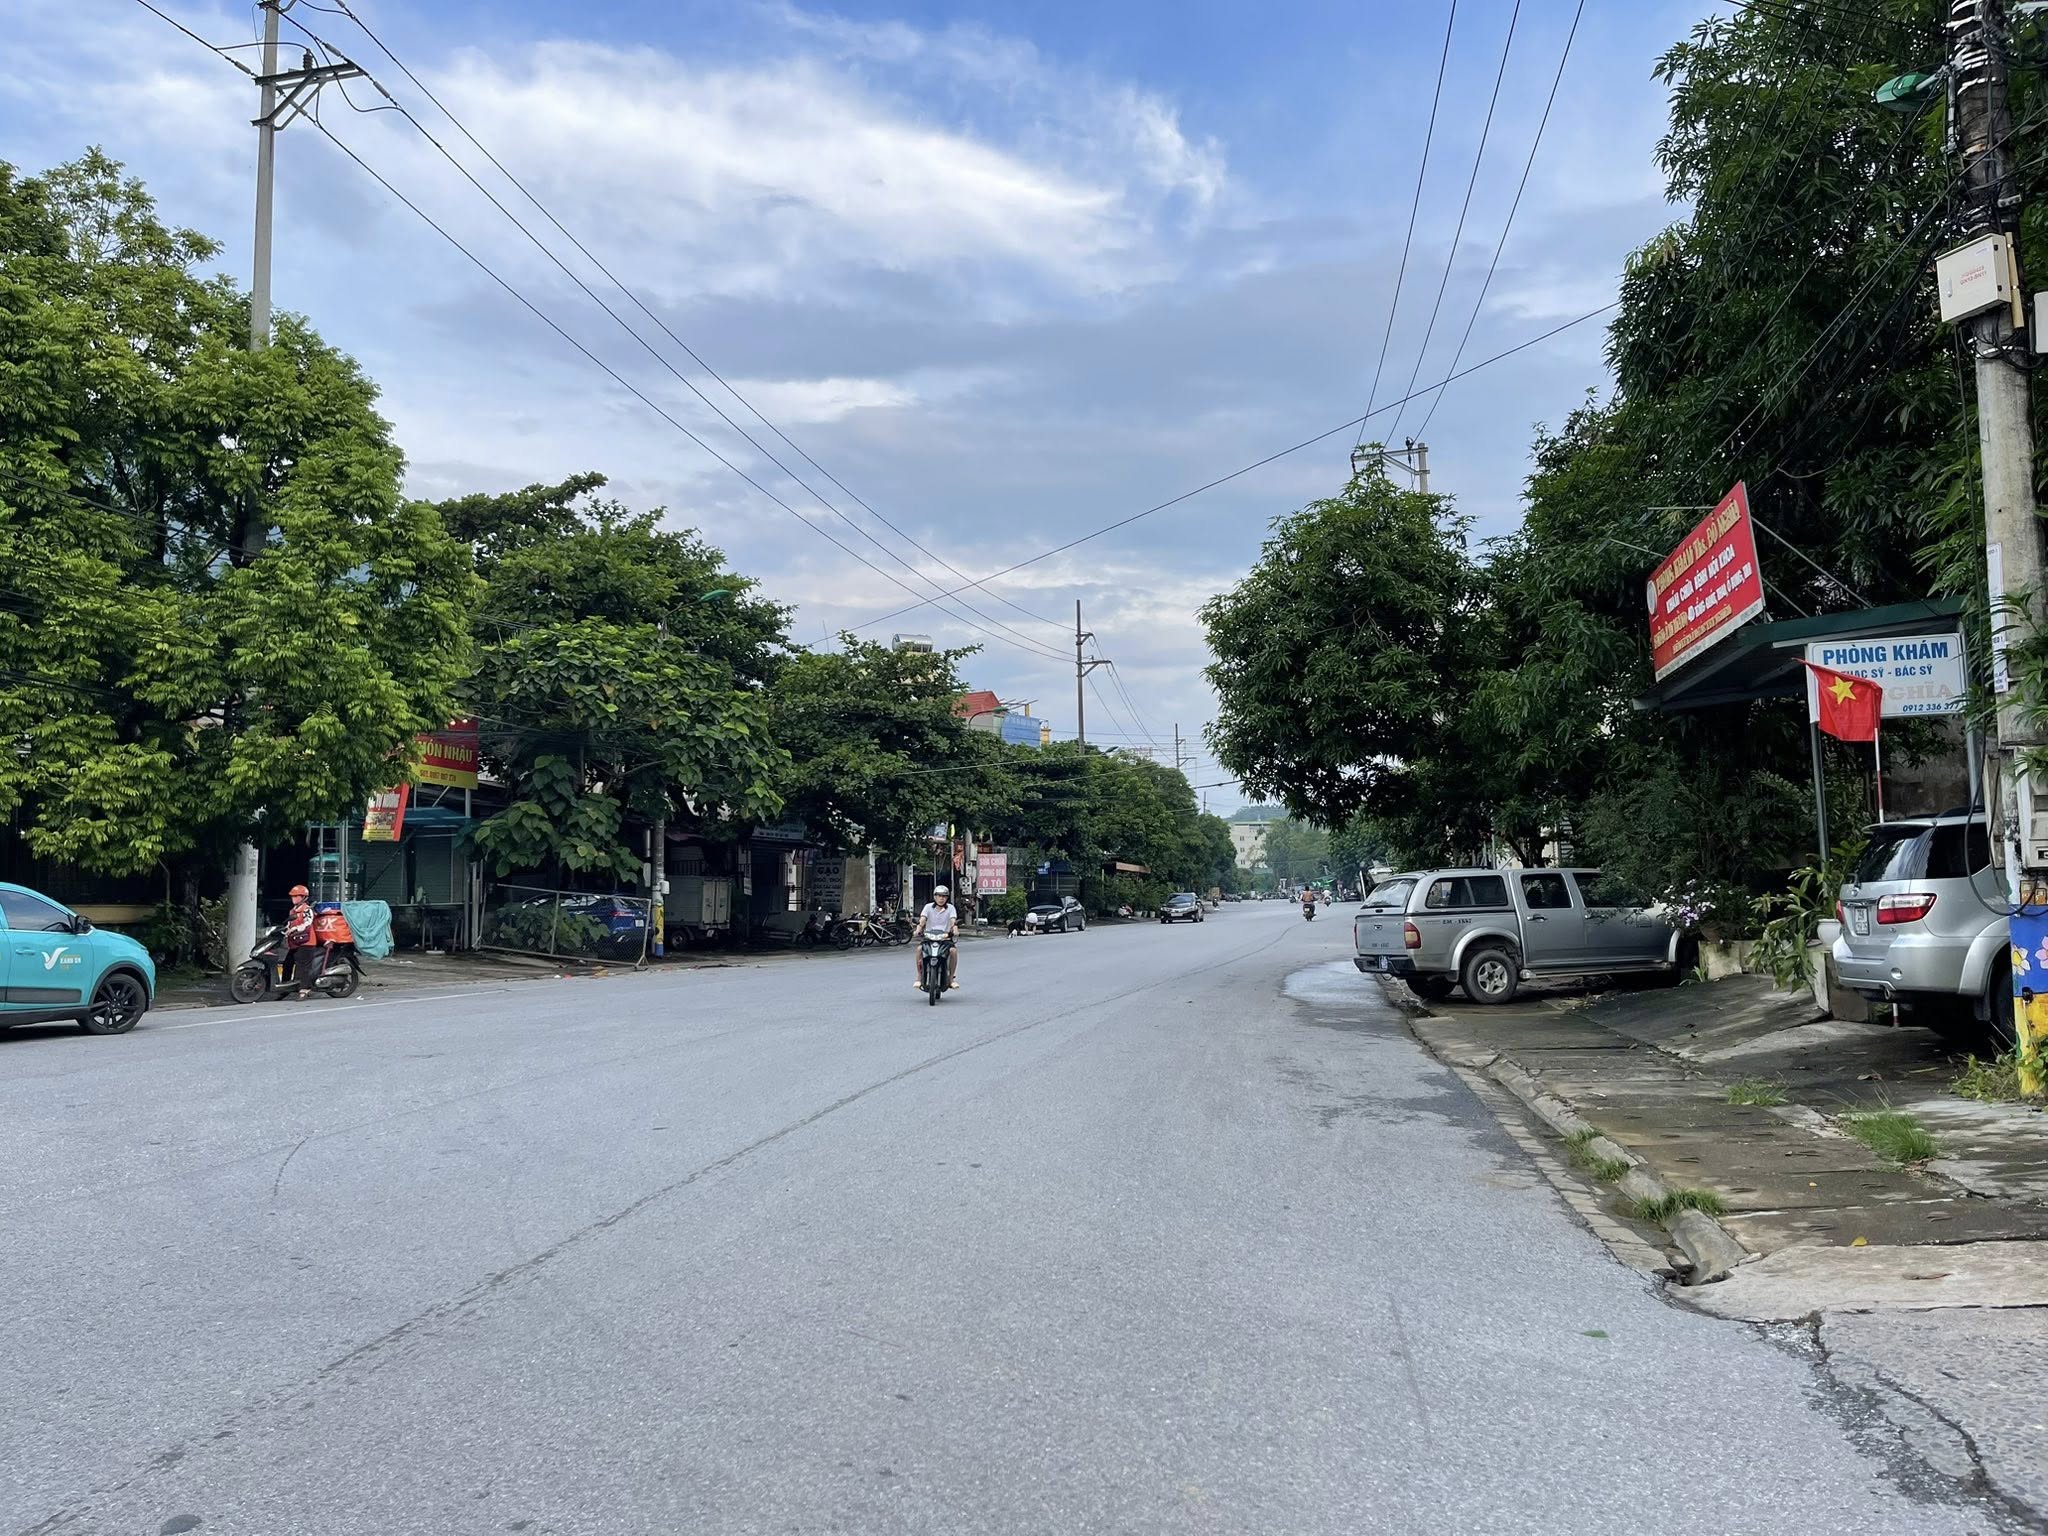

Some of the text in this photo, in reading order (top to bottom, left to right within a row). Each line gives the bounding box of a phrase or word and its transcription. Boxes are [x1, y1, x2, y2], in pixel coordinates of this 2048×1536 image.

[1823, 640, 1948, 665] PHÒNG KHÁM
[1895, 665, 1916, 677] BÁC
[1903, 704, 1923, 712] 0912
[1926, 703, 1941, 711] 336
